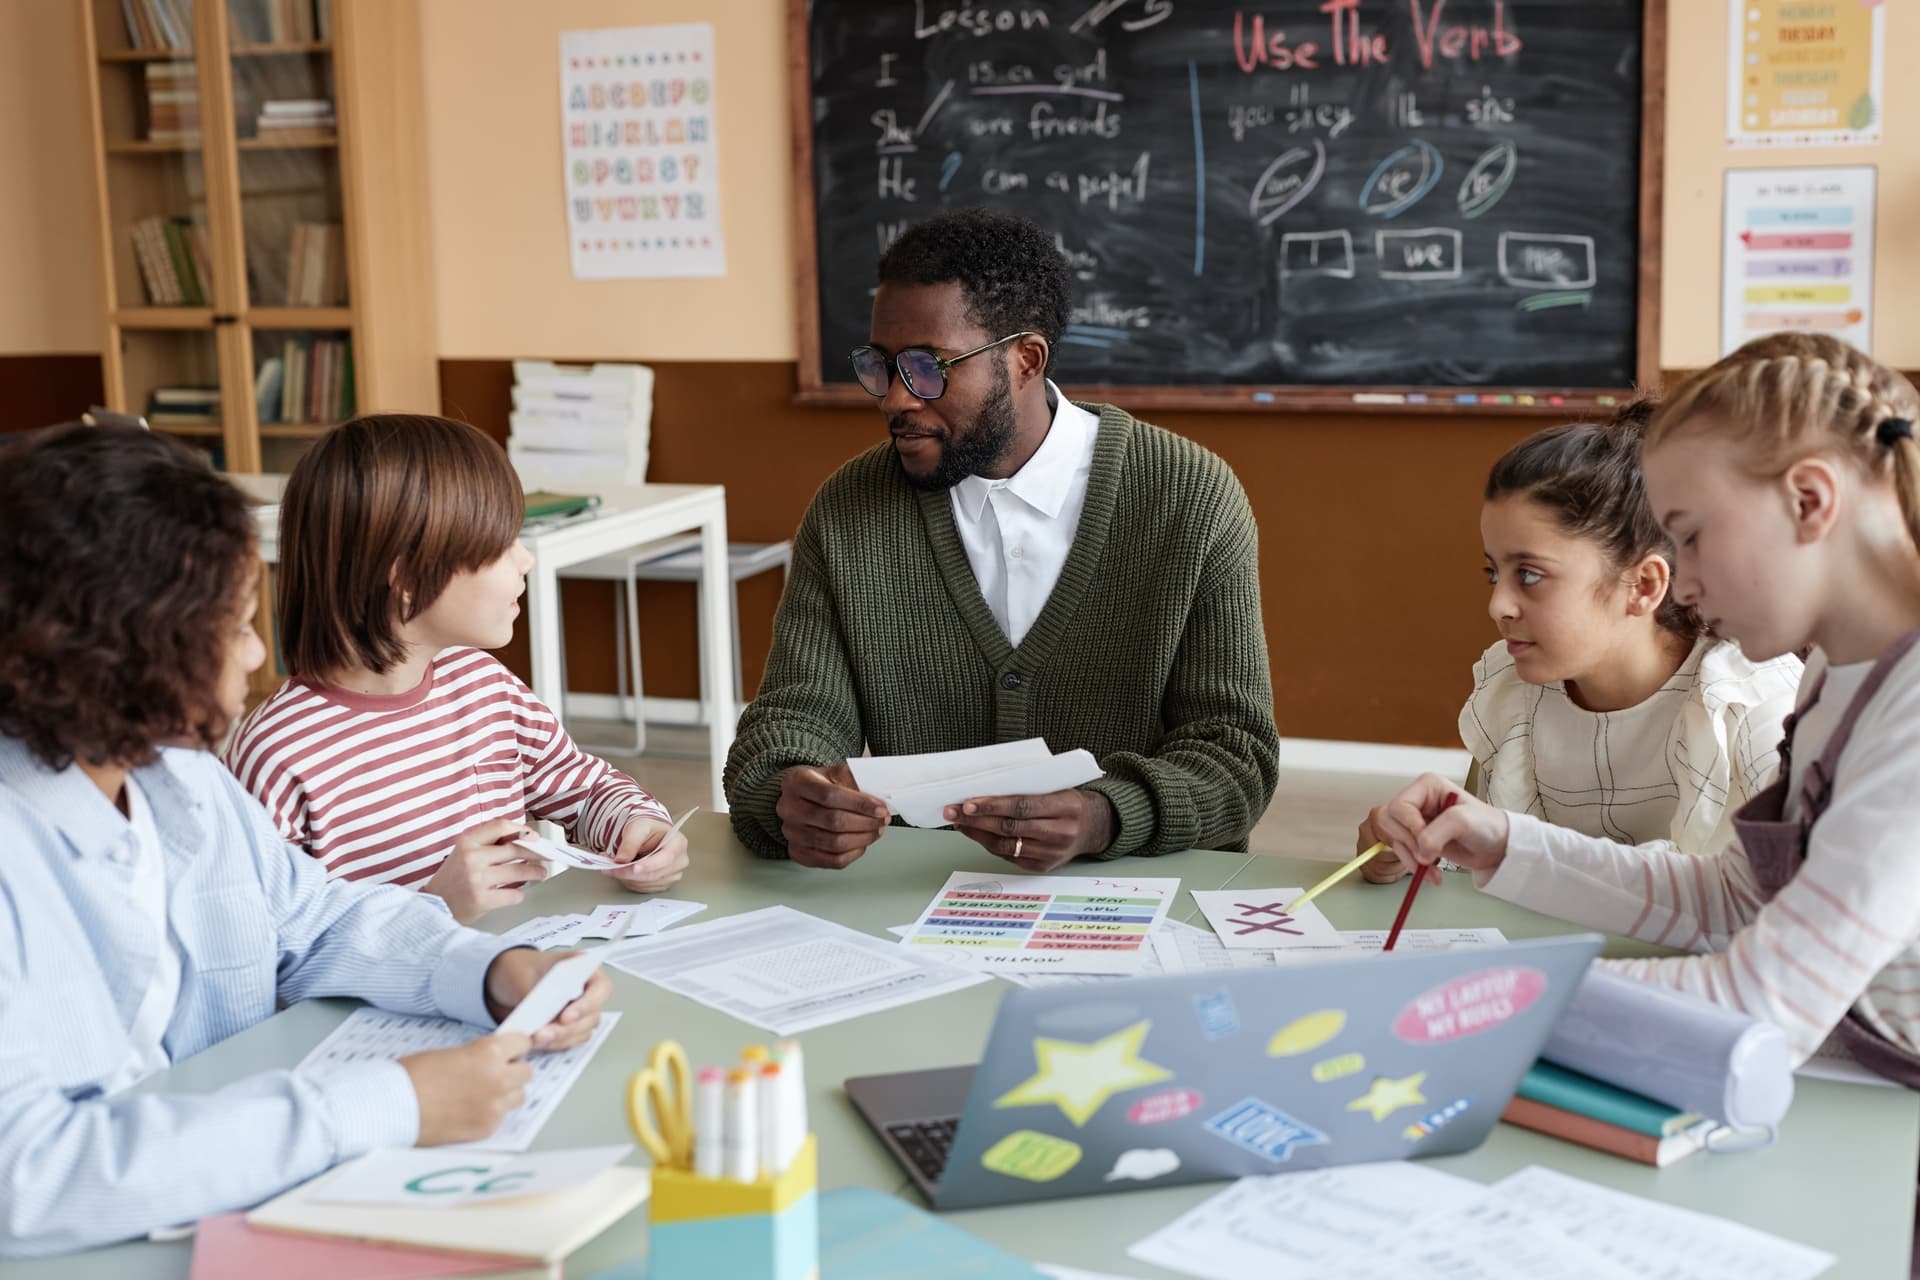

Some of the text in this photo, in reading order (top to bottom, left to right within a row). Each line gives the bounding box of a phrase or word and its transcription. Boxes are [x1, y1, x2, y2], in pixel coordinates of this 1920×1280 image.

[1233, 0, 1522, 72] Use The Verb
[956, 891, 1041, 901] DECEMBER
[948, 900, 1037, 910] NOVEMBER
[949, 910, 1024, 919] OCTOBER
[984, 955, 1064, 963] MONTHS
